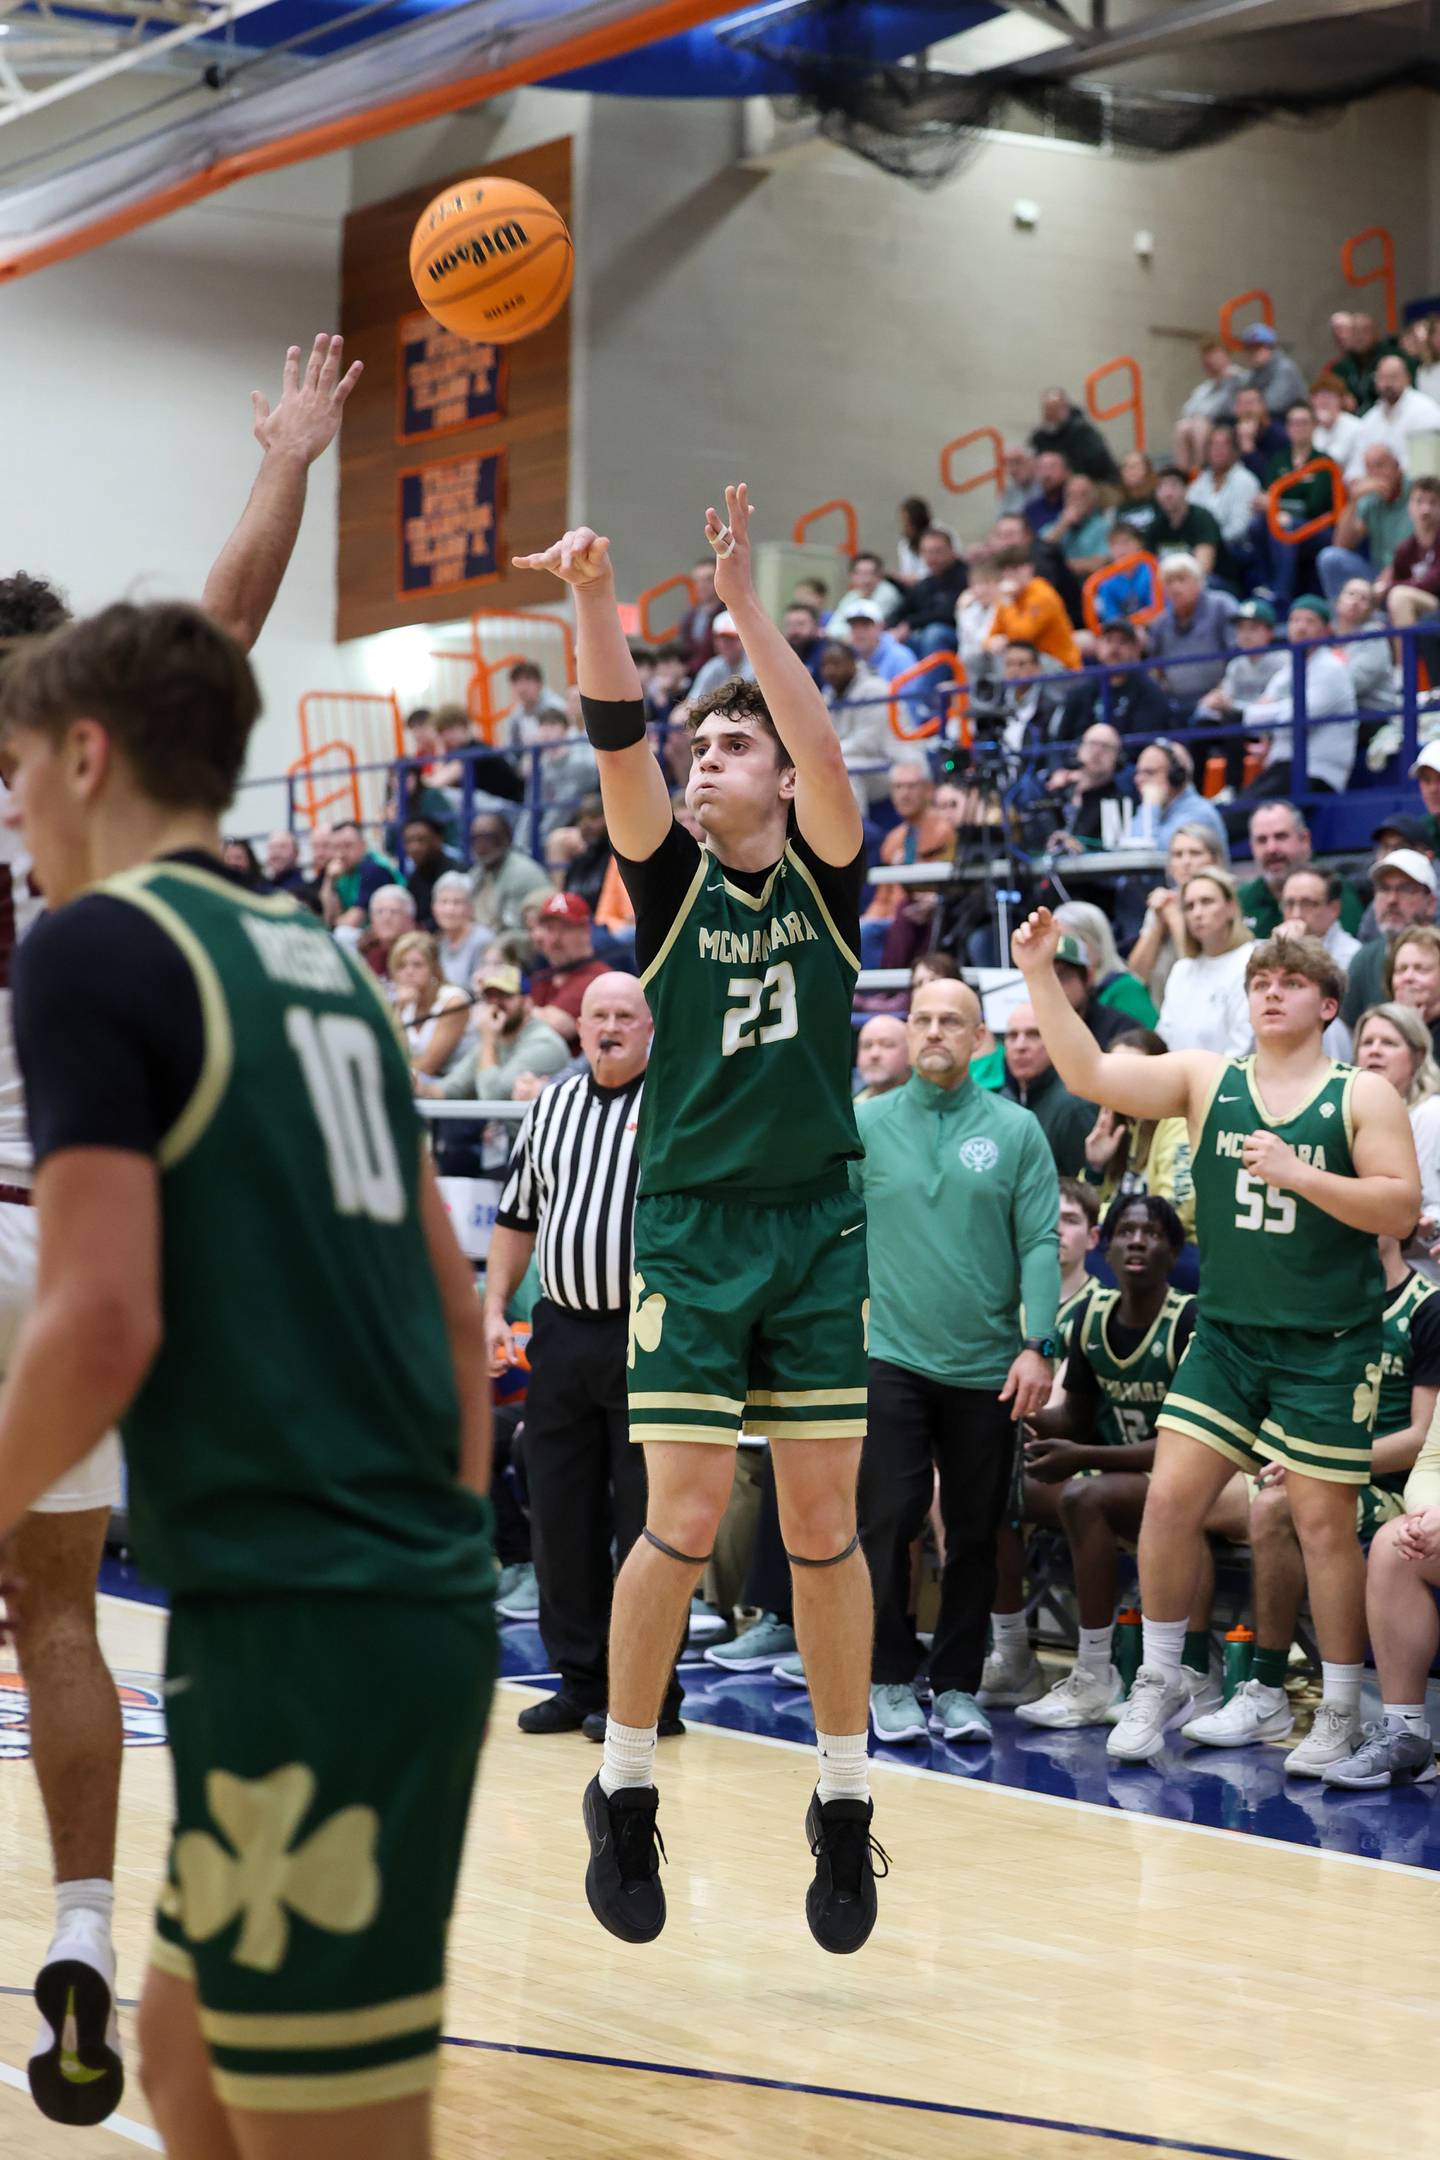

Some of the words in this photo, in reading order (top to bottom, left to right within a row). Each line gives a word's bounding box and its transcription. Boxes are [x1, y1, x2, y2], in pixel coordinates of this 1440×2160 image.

[722, 960, 799, 1057] 23
[285, 1005, 406, 1225] 10
[1216, 1130, 1326, 1171] MCRA
[1235, 1168, 1296, 1235] 55
